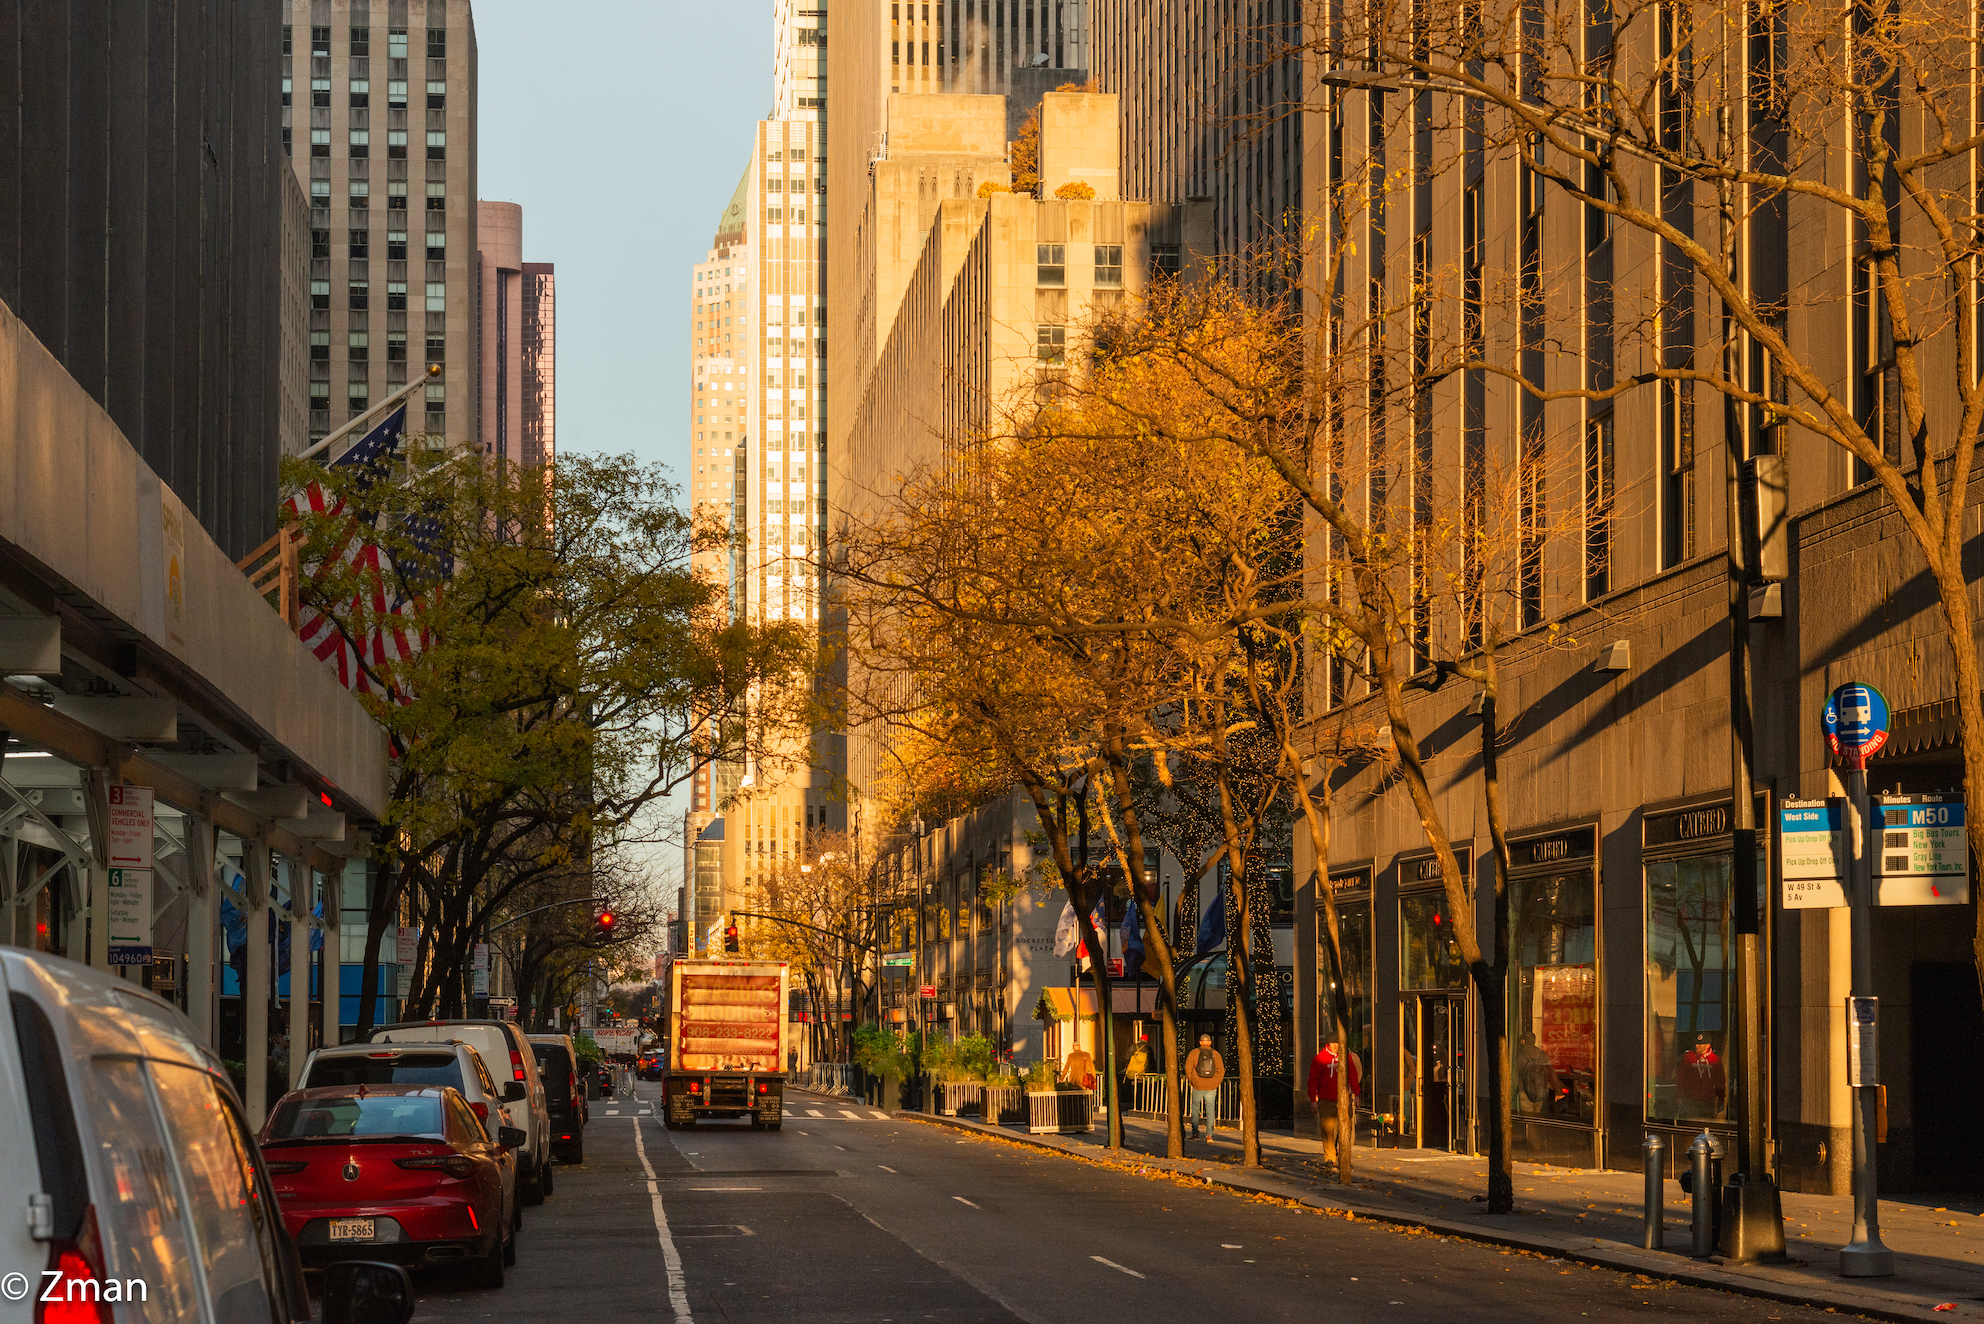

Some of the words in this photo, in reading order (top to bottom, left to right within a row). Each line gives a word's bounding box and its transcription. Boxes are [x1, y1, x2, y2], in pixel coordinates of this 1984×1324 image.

[1829, 737, 1841, 751] NO
[1843, 734, 1883, 757] STANDING
[113, 787, 120, 803] 3
[1883, 795, 1912, 804] Minutes
[1922, 794, 1943, 803] Route
[1785, 799, 1825, 809] Destination
[111, 808, 145, 818] COMMERCIAL
[1784, 812, 1802, 821] West
[1803, 812, 1819, 820] Side
[1912, 807, 1949, 825] M50
[111, 817, 136, 826] VEHICLES
[136, 819, 150, 827] ONLY
[1679, 807, 1726, 838] CATBIRD
[1785, 835, 1796, 843] Pick
[1819, 834, 1827, 842] Off
[1827, 834, 1840, 843] Only
[1913, 829, 1924, 839] Big
[1926, 829, 1939, 838] Bus
[1941, 828, 1960, 837] Tours
[1533, 836, 1568, 862] CATBIRD
[1913, 841, 1928, 849] New
[1930, 840, 1946, 849] York
[1913, 852, 1927, 862] Gray
[1929, 851, 1942, 861] Line
[1786, 858, 1797, 866] Pick
[1913, 863, 1925, 872] New
[1926, 863, 1938, 871] York
[1938, 862, 1954, 871] Tours,
[1954, 861, 1964, 871] Inc.
[111, 871, 120, 886] 6
[1787, 883, 1795, 891] W
[1796, 883, 1805, 891] 49
[110, 891, 127, 899] Monday
[1787, 893, 1793, 901] 5
[1793, 893, 1803, 901] Av
[122, 899, 139, 907] Midnight
[109, 953, 143, 964] 104960
[595, 1028, 635, 1037] SUPERCAP
[686, 1026, 773, 1039] 908-233-8222
[331, 1224, 374, 1237] TYR-5865
